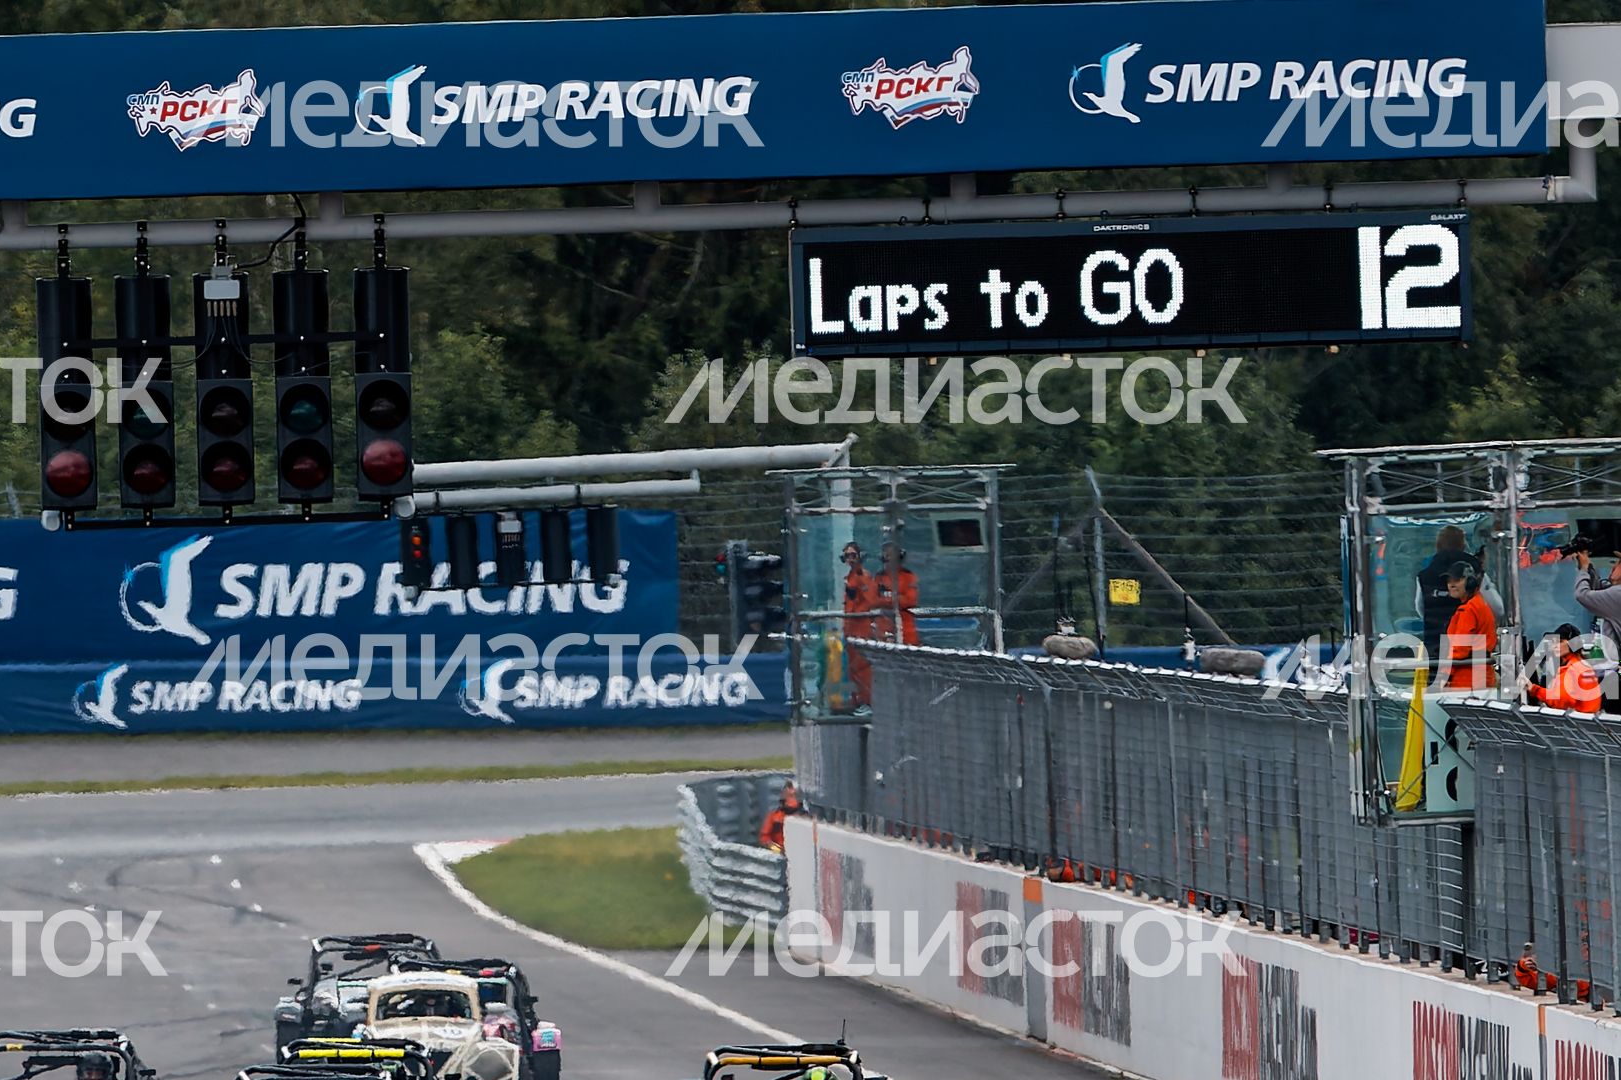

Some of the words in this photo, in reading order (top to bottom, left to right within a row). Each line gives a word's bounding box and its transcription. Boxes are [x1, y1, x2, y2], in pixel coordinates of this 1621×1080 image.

[875, 76, 953, 100] РСКГ
[1146, 63, 1261, 103] SMP
[1270, 59, 1467, 100] RACING
[160, 99, 238, 122] РСКГ
[431, 85, 547, 125] SMP
[556, 77, 752, 120] RACING
[1093, 223, 1150, 231] DAKTRONICS
[1430, 213, 1467, 221] GALAXY
[809, 258, 949, 334] Laps
[980, 269, 1049, 328] to
[1080, 248, 1184, 325] GO
[1358, 224, 1462, 330] 12
[217, 563, 364, 619] SMP
[130, 680, 213, 713] SMP
[219, 678, 363, 712] RACING
[514, 674, 599, 708] SMP
[607, 671, 750, 707] RACING
